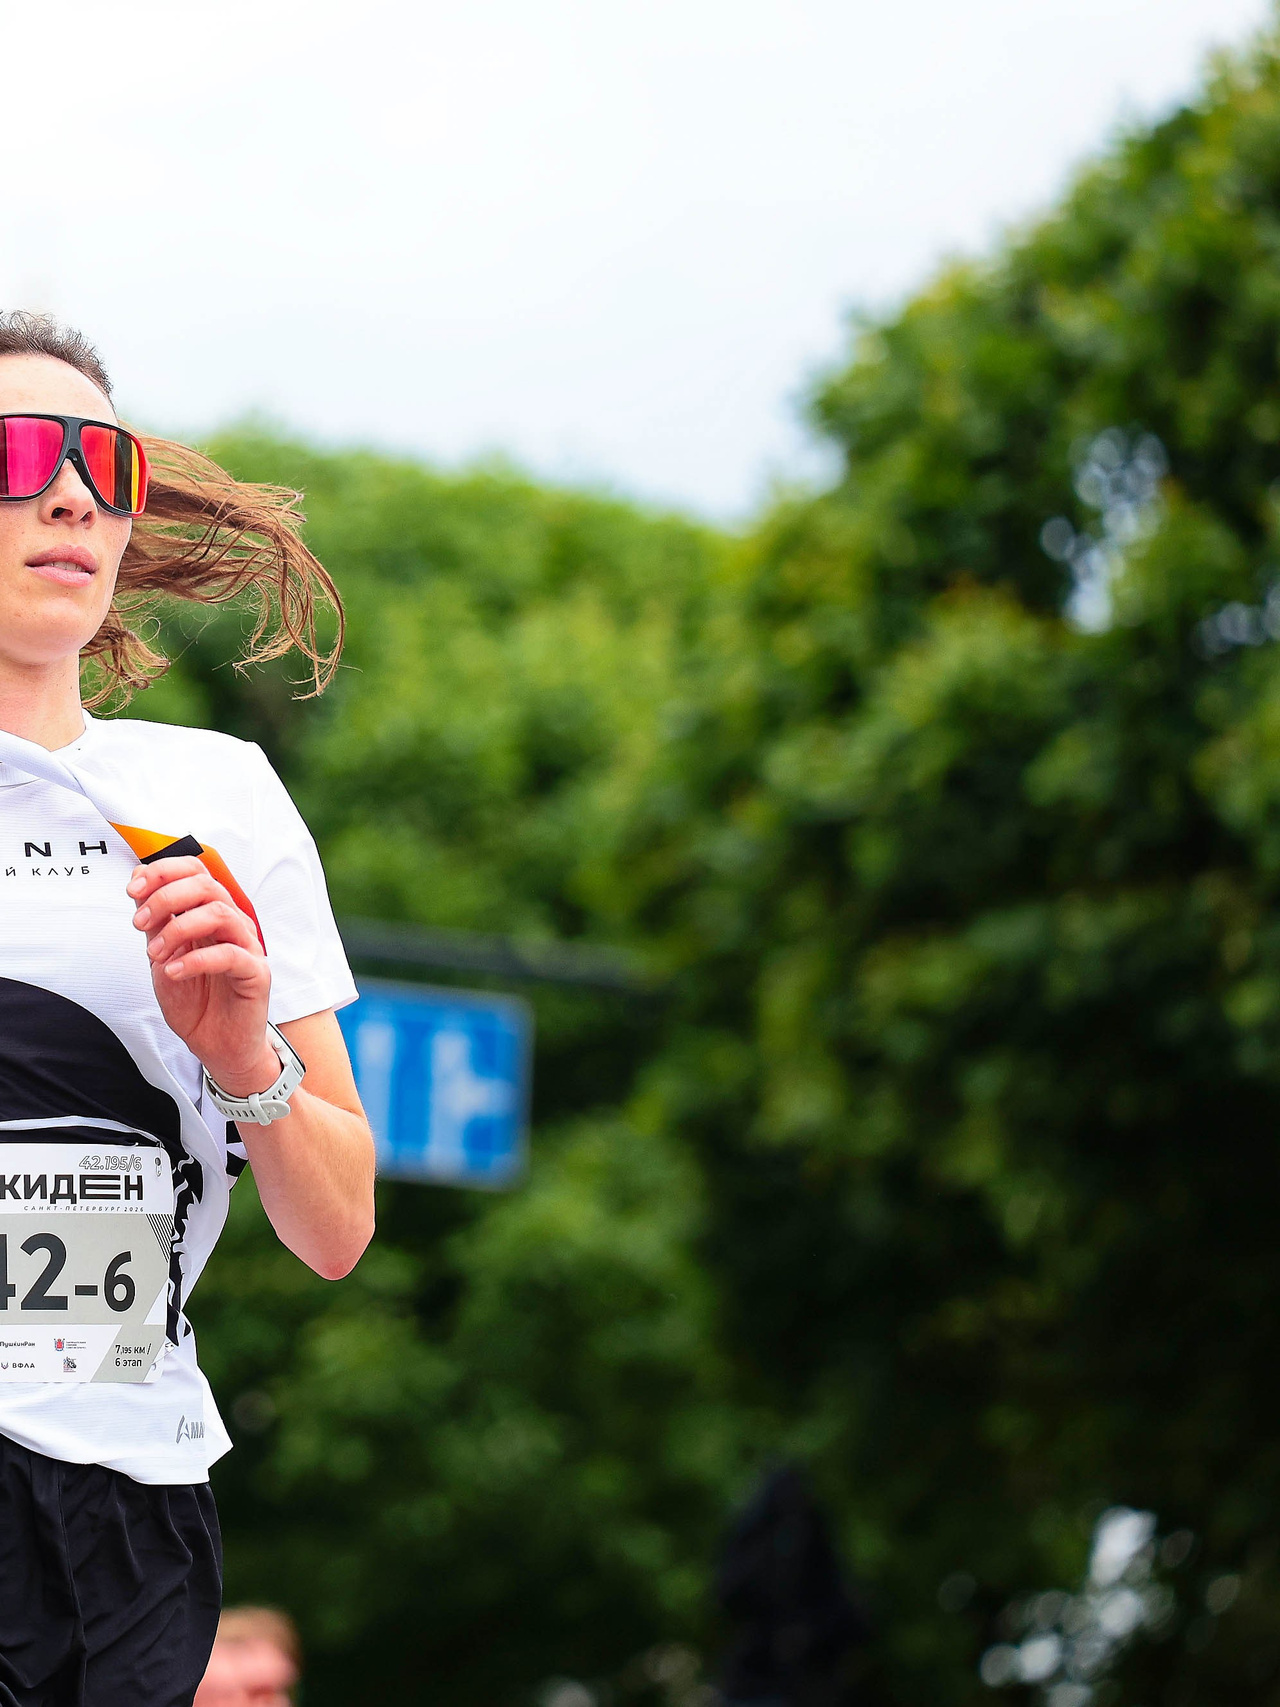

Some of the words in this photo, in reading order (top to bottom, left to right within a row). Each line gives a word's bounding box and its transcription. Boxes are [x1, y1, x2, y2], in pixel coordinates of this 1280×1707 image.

[31, 865, 91, 877] КЛУБ
[78, 1154, 143, 1173] 42.195/6
[115, 1357, 121, 1367] 6
[122, 1359, 142, 1367] этап
